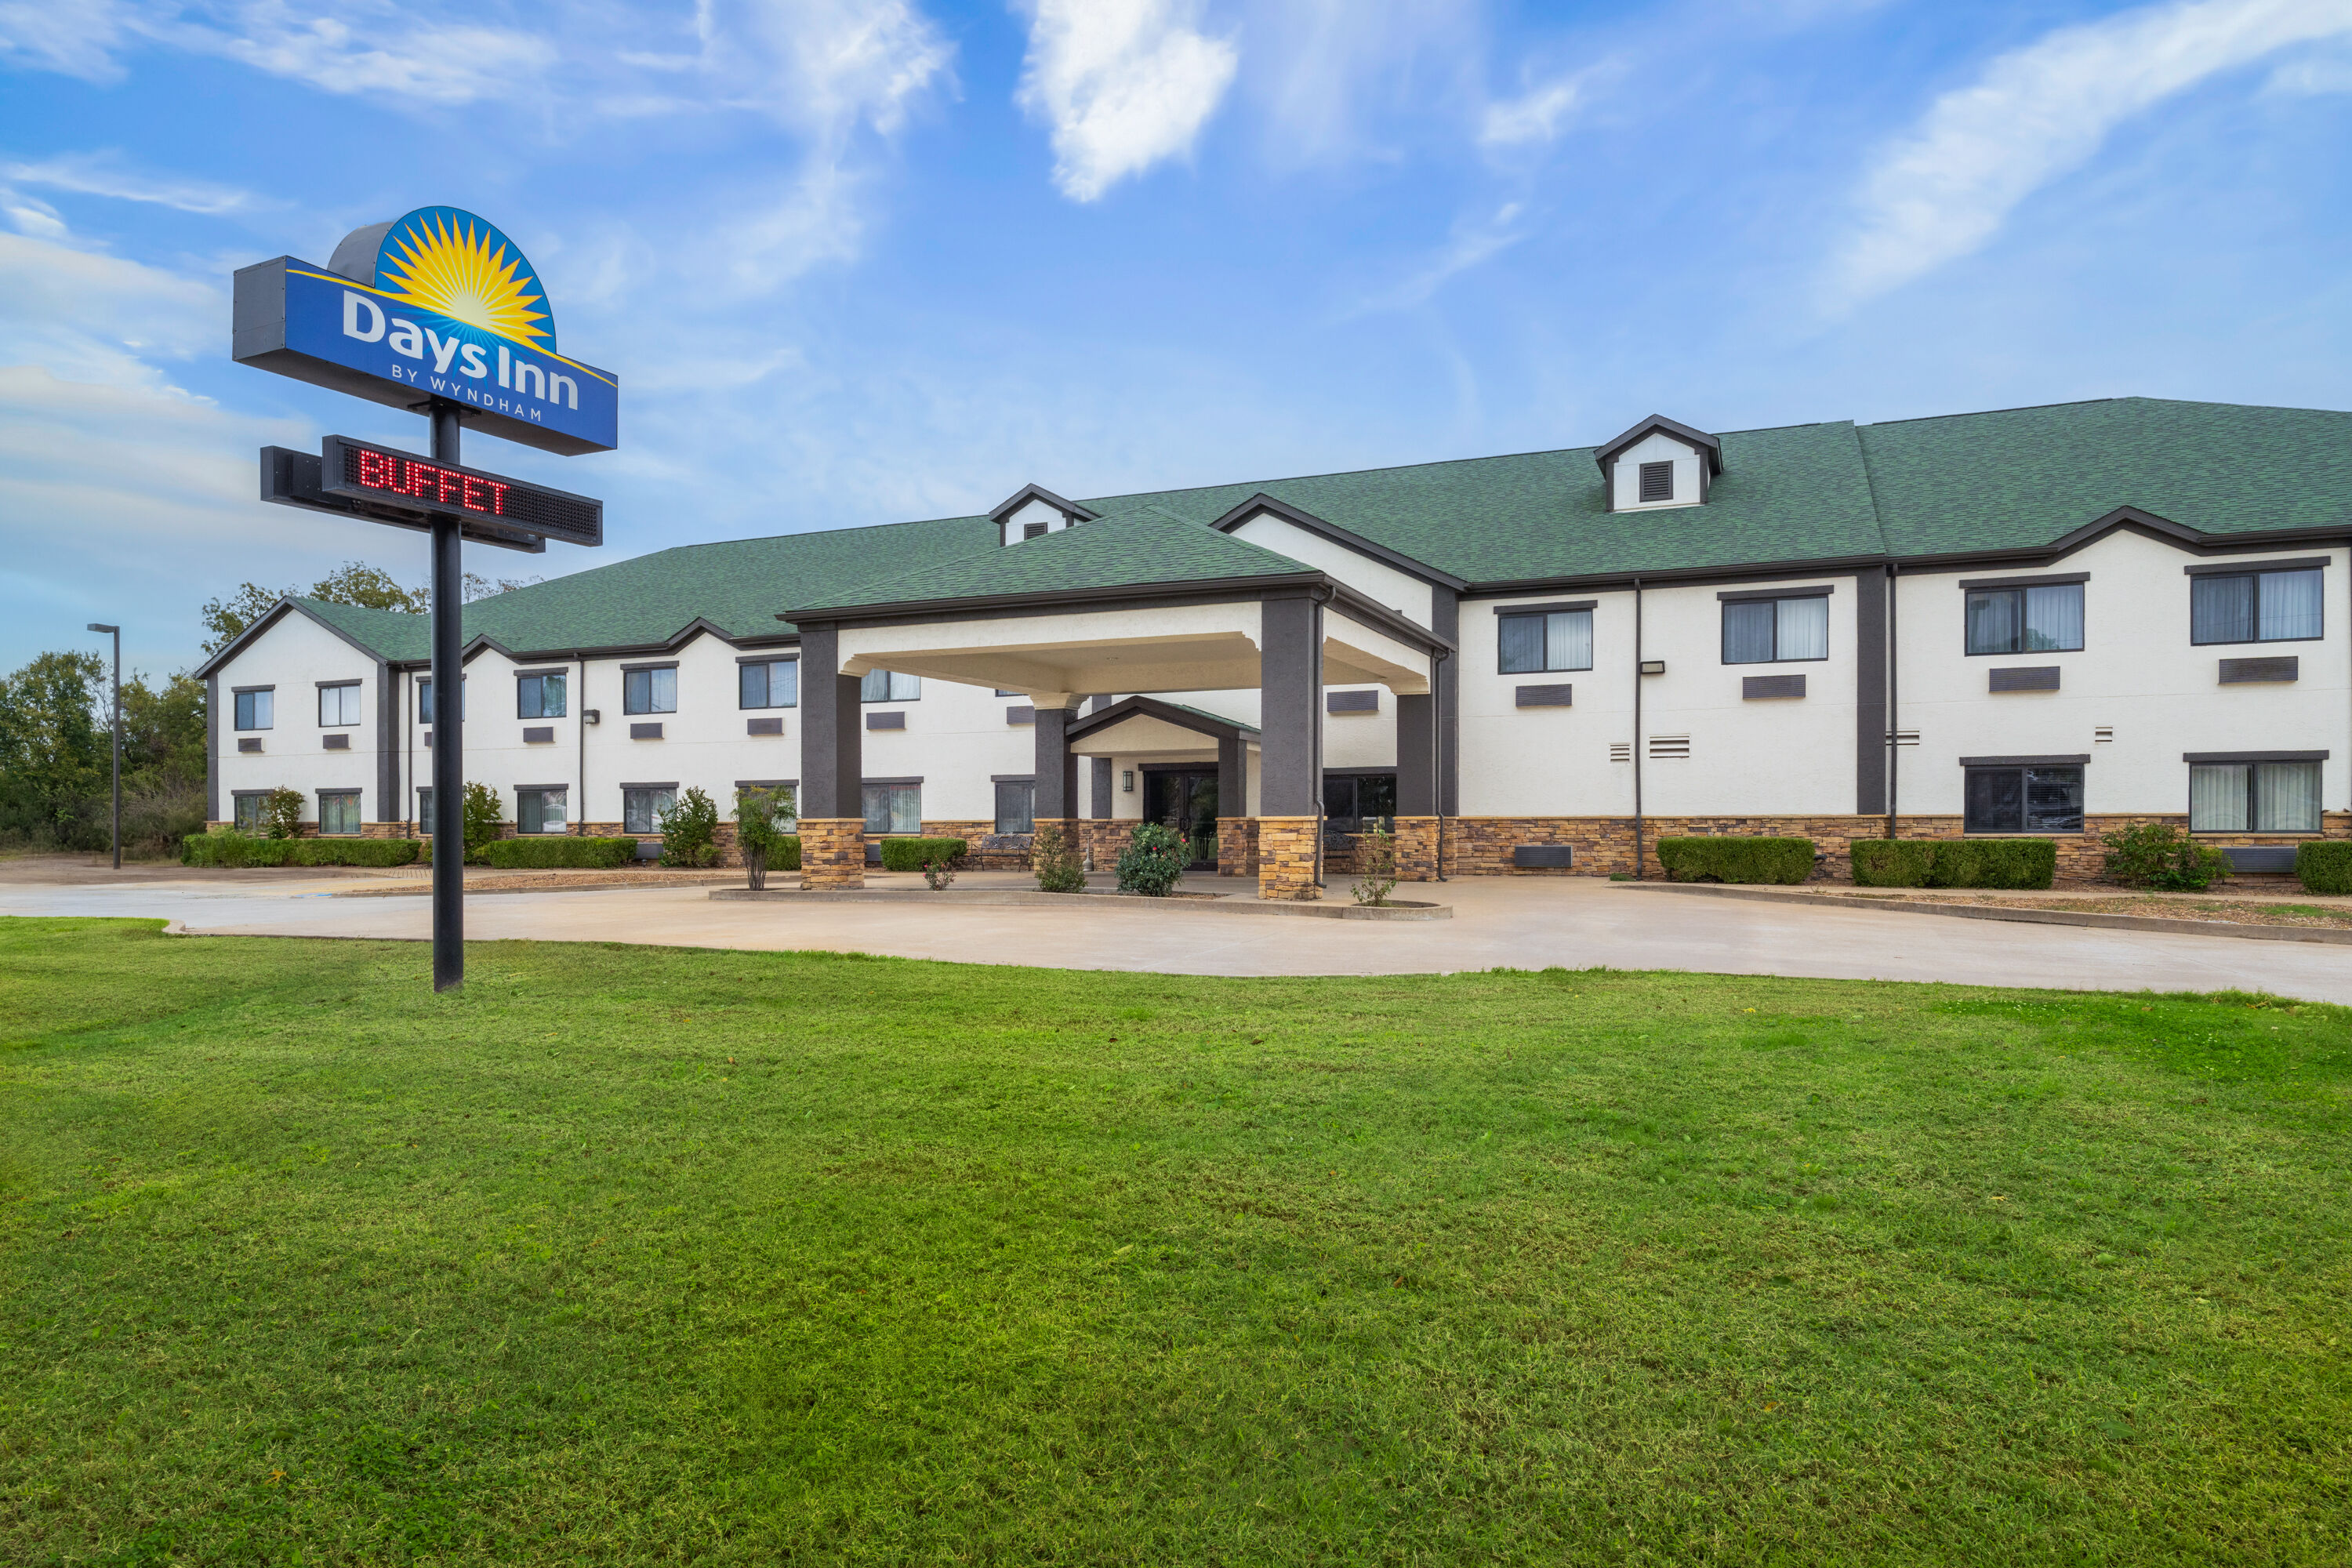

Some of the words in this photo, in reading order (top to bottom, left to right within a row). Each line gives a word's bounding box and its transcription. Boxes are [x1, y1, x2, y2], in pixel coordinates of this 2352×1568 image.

[343, 290, 488, 379] Days
[498, 345, 579, 411] Inn
[391, 364, 418, 383] BY
[430, 376, 542, 423] WYNDHAM
[360, 449, 511, 515] BUFFET
